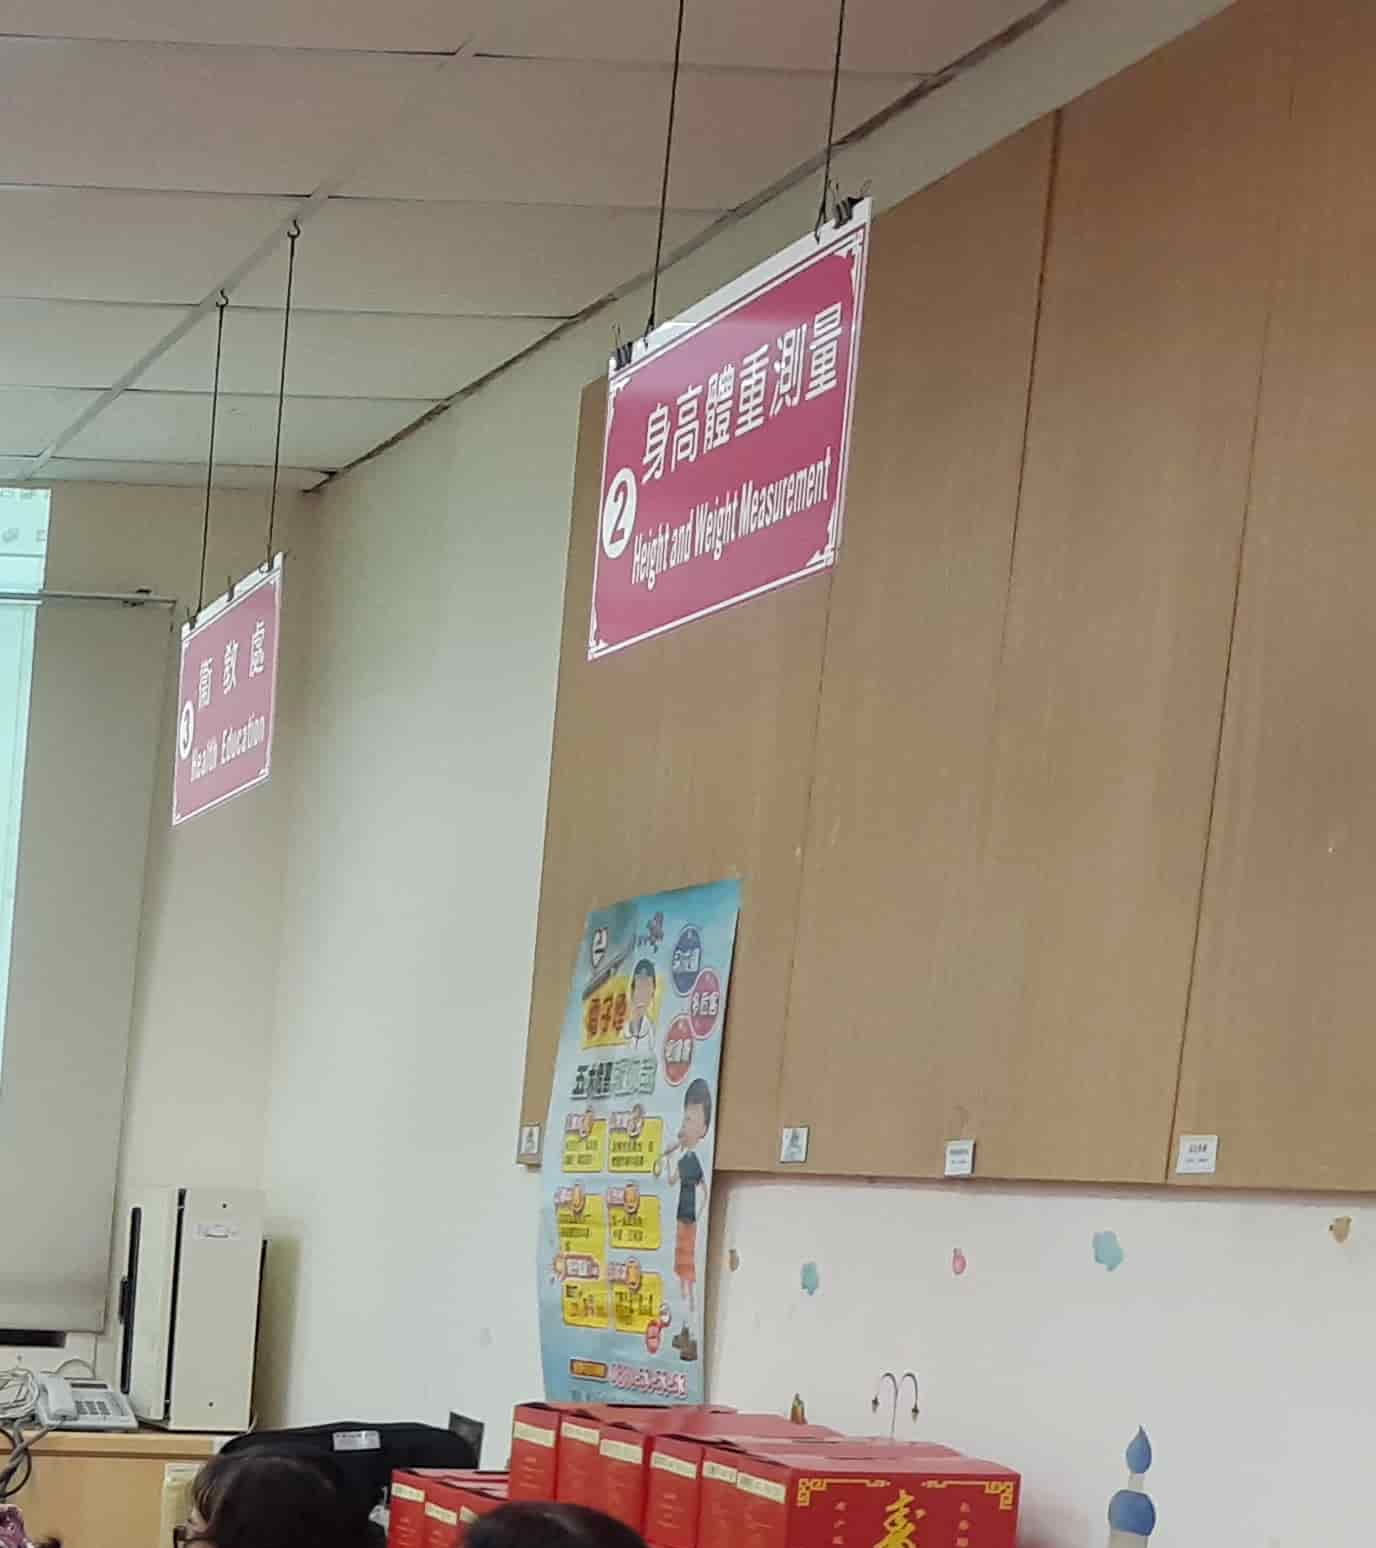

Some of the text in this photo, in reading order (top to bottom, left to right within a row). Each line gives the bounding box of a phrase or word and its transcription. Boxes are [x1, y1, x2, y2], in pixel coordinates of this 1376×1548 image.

[642, 302, 842, 484] 身高體重測量
[631, 446, 832, 590] Height and Weight Measurement
